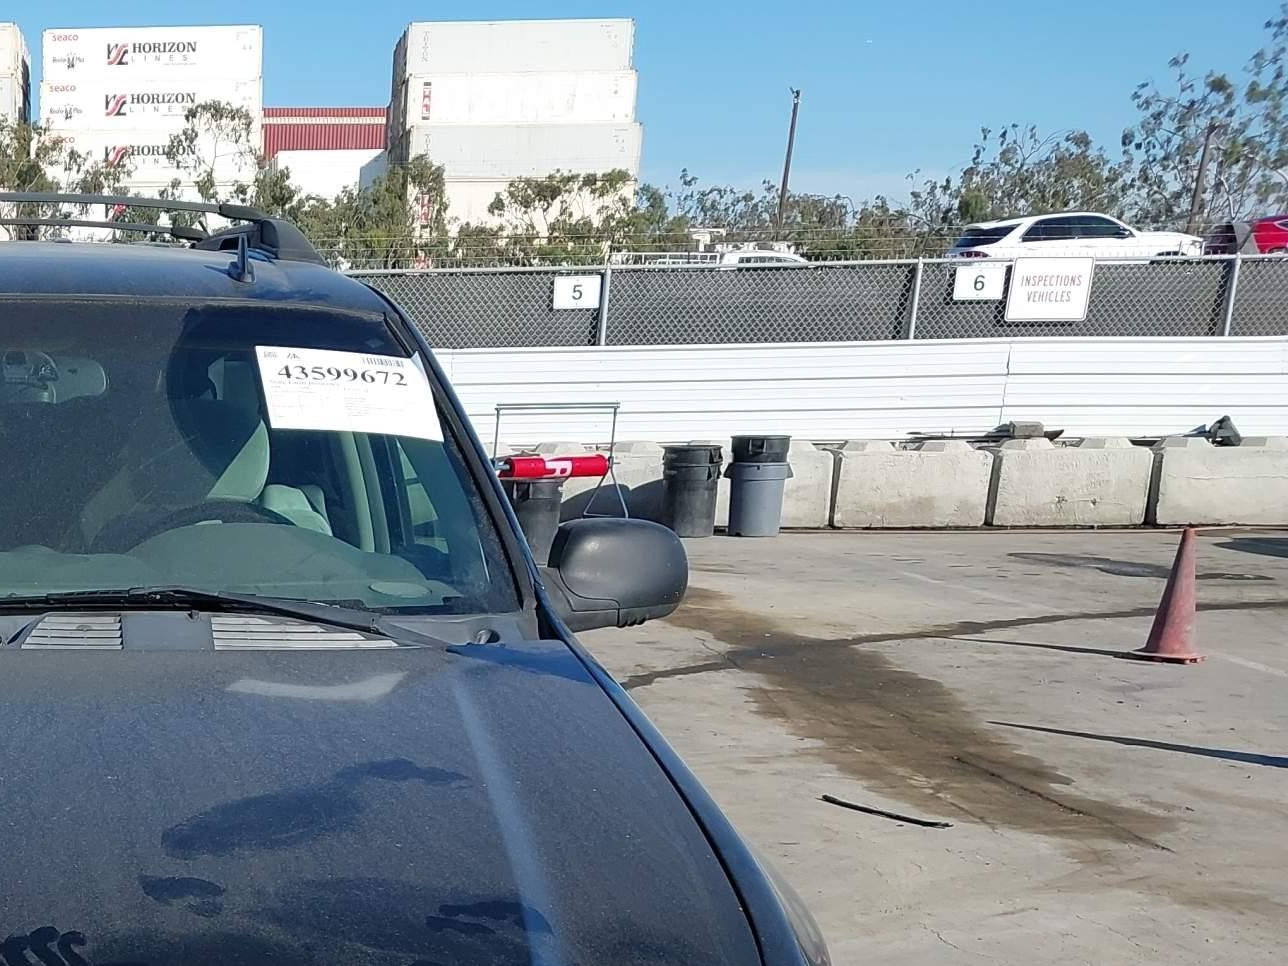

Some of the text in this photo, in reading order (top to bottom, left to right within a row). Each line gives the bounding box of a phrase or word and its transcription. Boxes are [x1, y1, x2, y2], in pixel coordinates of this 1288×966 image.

[52, 33, 79, 42] seaco
[132, 41, 197, 54] HORIZON
[131, 54, 188, 62] LINES
[49, 84, 76, 93] seaco
[130, 92, 196, 105] HORIZON
[973, 274, 985, 291] 6
[1020, 274, 1083, 287] INSPECTIONS
[572, 284, 583, 300] 5
[1026, 290, 1072, 303] VEHICLES
[277, 363, 408, 386] 43599672
